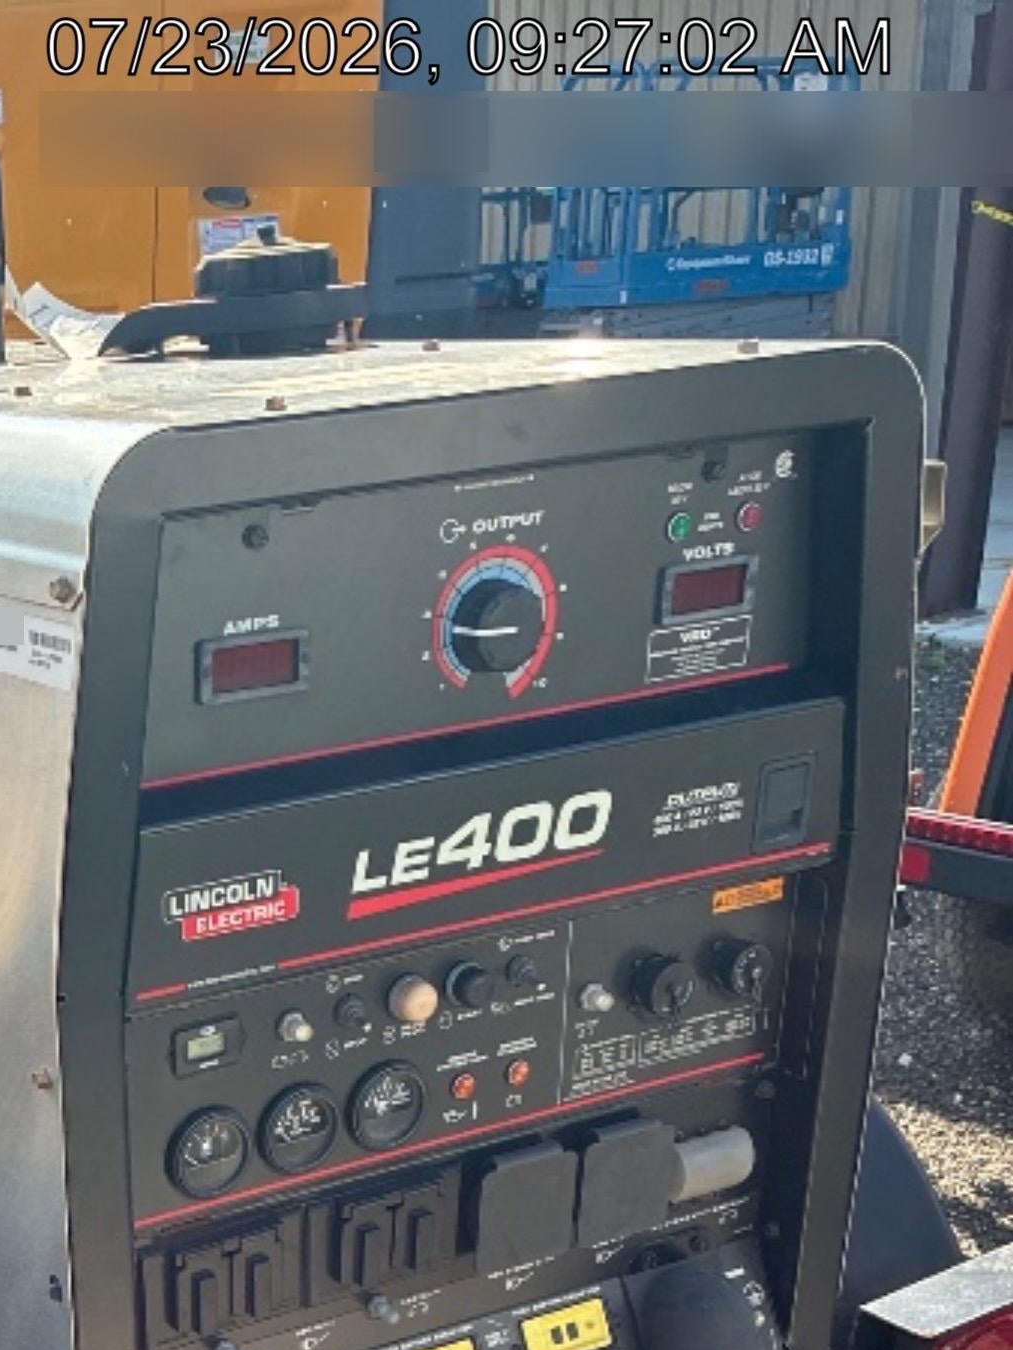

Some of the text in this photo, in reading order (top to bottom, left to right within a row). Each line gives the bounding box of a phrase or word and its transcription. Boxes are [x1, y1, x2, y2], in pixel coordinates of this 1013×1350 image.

[472, 510, 545, 534] OUTPUT
[683, 542, 735, 560] VOLTS
[224, 614, 279, 636] AMPS
[352, 790, 613, 893] LE400
[169, 875, 274, 917] LINCOLN
[196, 900, 286, 935] ELECTRIC
